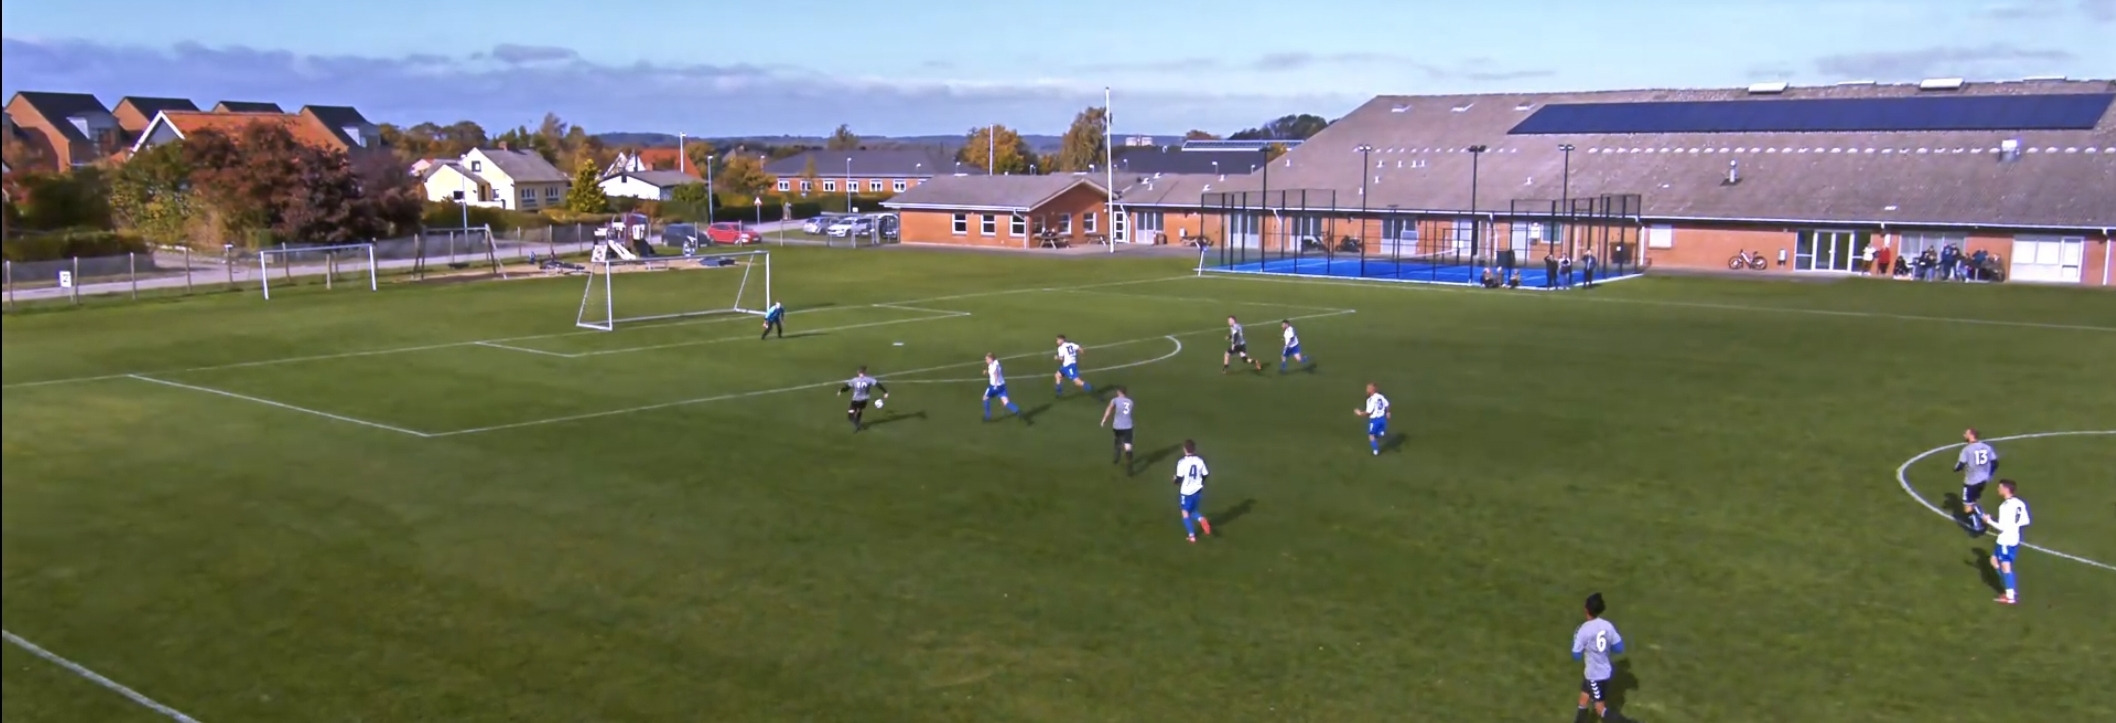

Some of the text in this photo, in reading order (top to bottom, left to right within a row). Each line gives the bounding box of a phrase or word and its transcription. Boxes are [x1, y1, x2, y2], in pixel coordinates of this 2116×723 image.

[1123, 401, 1130, 415] 3
[1974, 449, 1988, 465] 13
[1188, 464, 1198, 480] 4
[1596, 629, 1607, 653] 6
